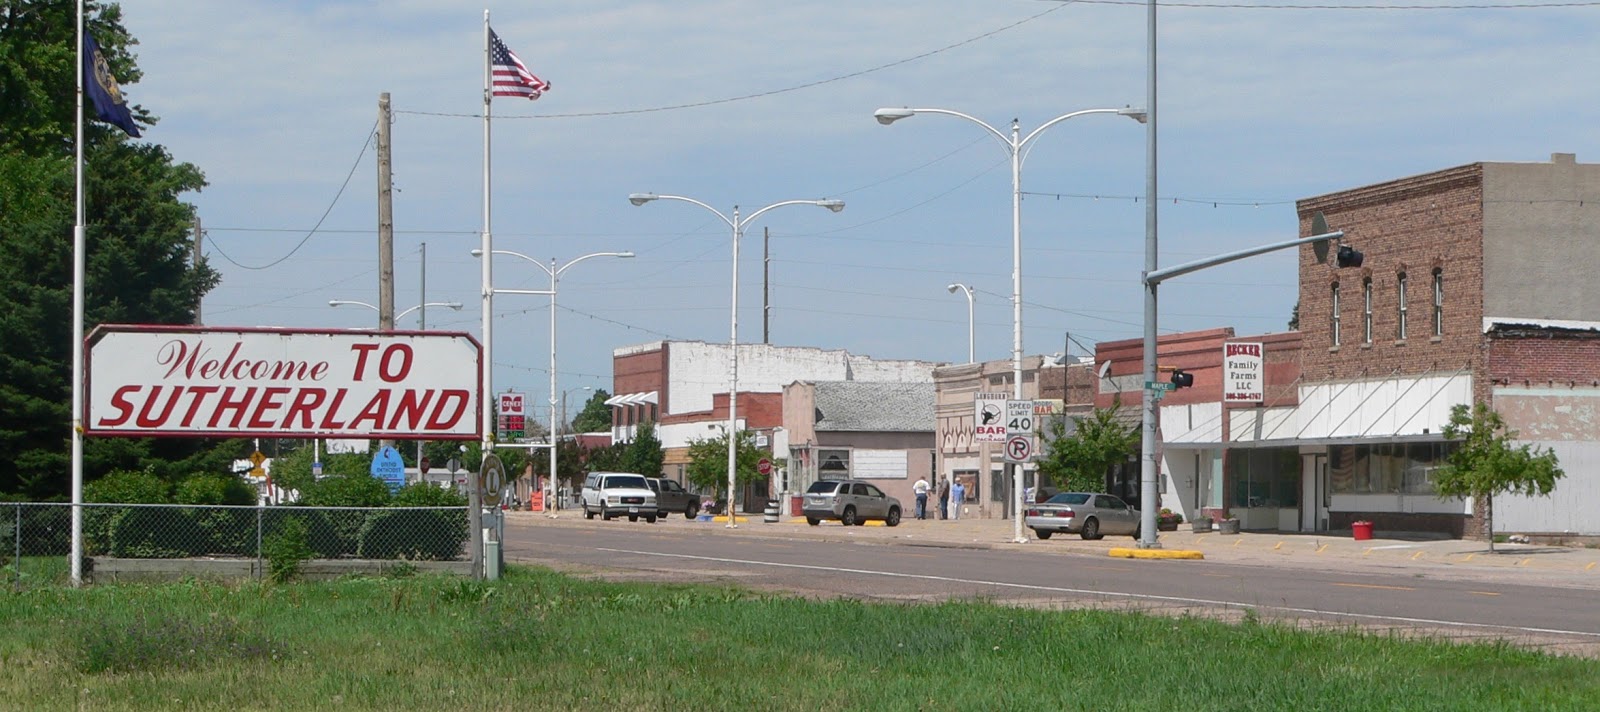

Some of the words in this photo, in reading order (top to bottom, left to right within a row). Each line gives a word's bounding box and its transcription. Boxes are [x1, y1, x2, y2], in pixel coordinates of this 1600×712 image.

[1226, 344, 1260, 358] BECKER
[156, 339, 329, 380] Welcome
[352, 343, 414, 383] TO
[1228, 361, 1258, 371] Family
[1230, 371, 1257, 380] Farms
[1151, 382, 1168, 390] MAPLE
[1236, 381, 1252, 390] LLC
[98, 385, 470, 431] SUTHERLAND
[502, 400, 522, 408] CENEX
[1034, 405, 1053, 414] BAR
[1008, 417, 1031, 431] 40
[976, 426, 1006, 435] BAR
